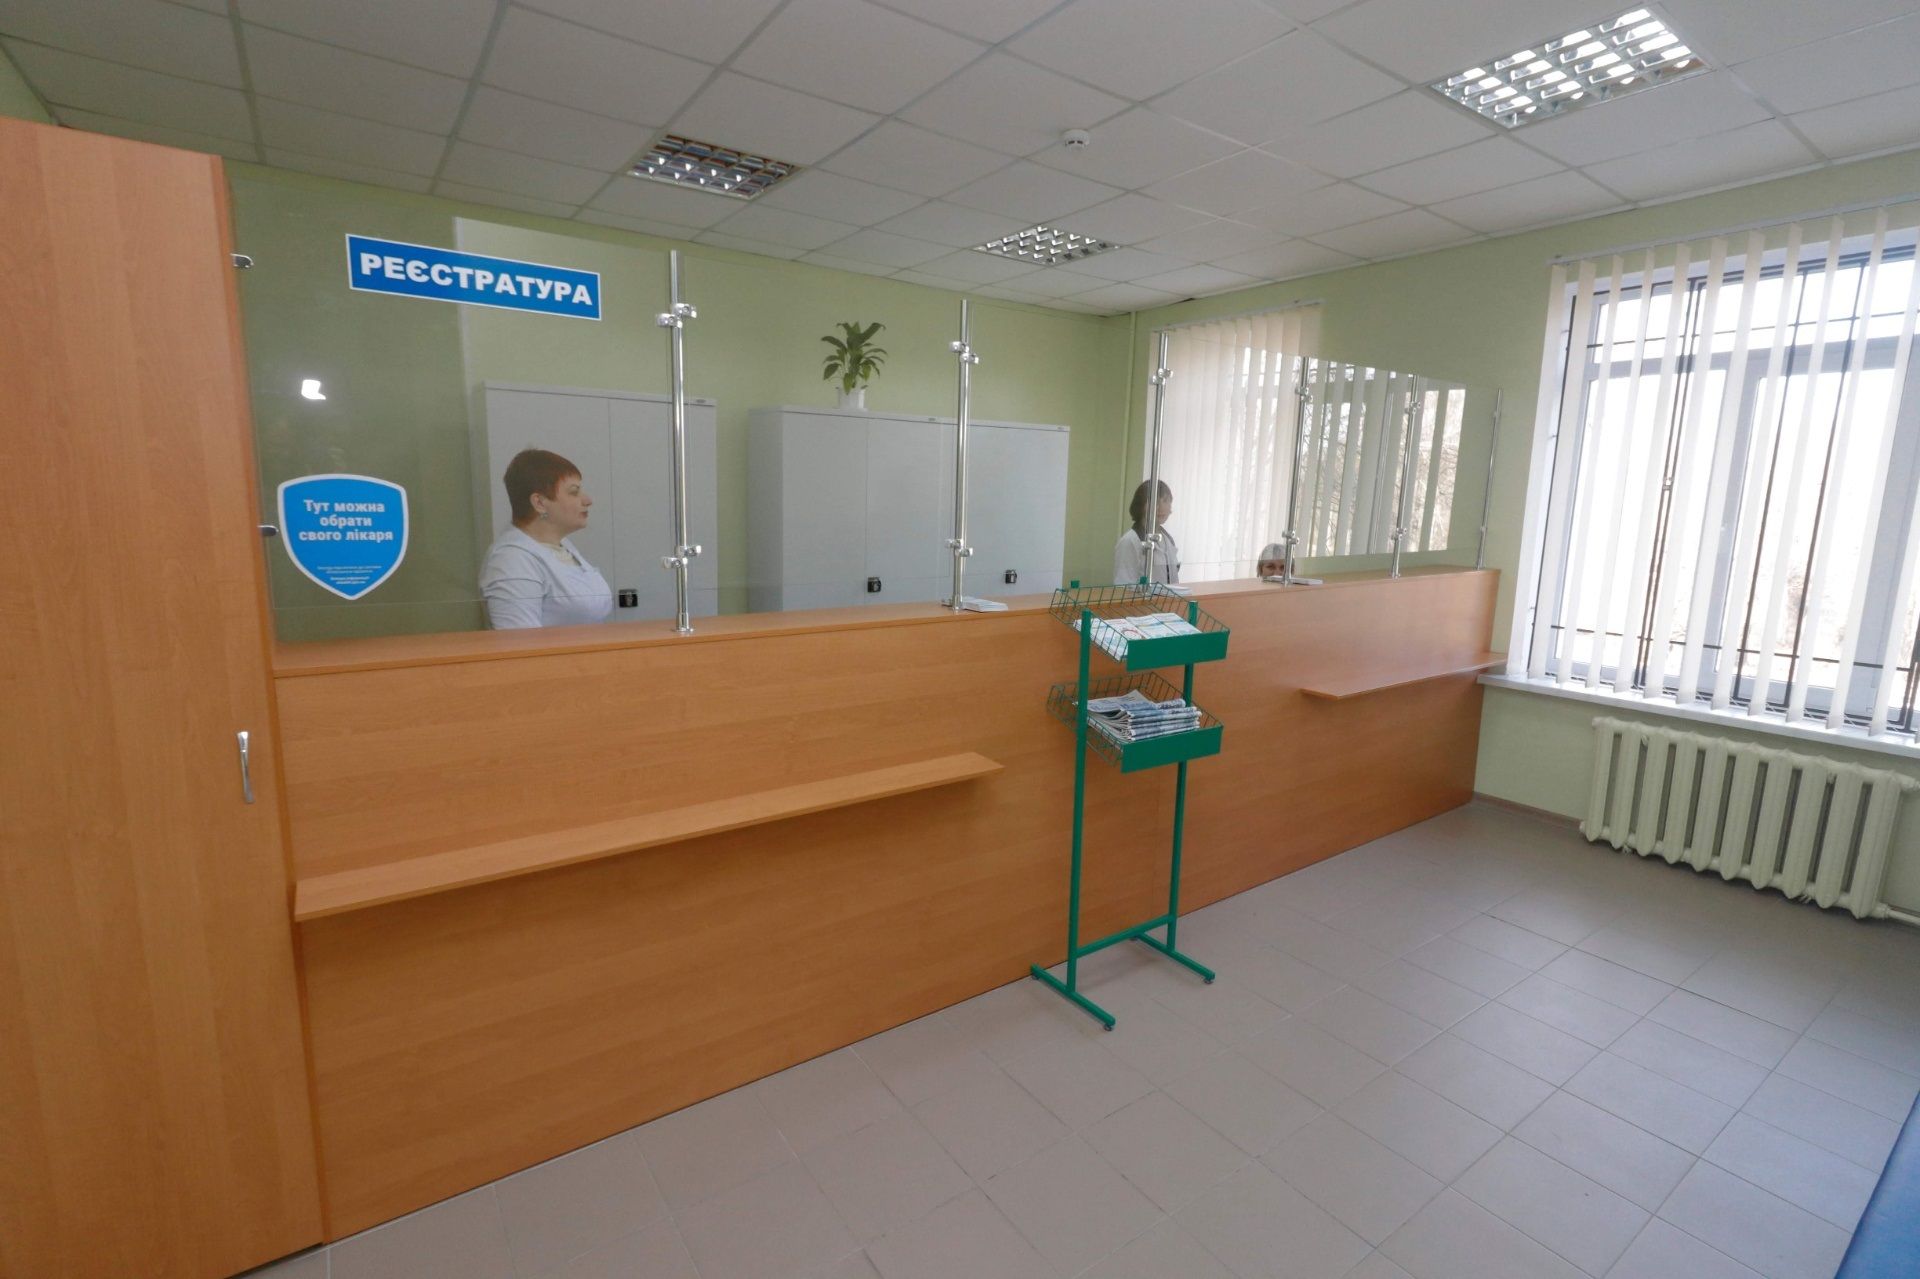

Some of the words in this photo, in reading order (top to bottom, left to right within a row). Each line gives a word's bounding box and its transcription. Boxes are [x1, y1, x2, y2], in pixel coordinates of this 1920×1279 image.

[360, 252, 593, 306] РЕЄСТРАТУРА
[303, 499, 330, 515] Тут
[334, 501, 385, 513] можна
[320, 514, 372, 529] обрати
[299, 530, 342, 542] свого
[345, 529, 393, 543] лікаря
